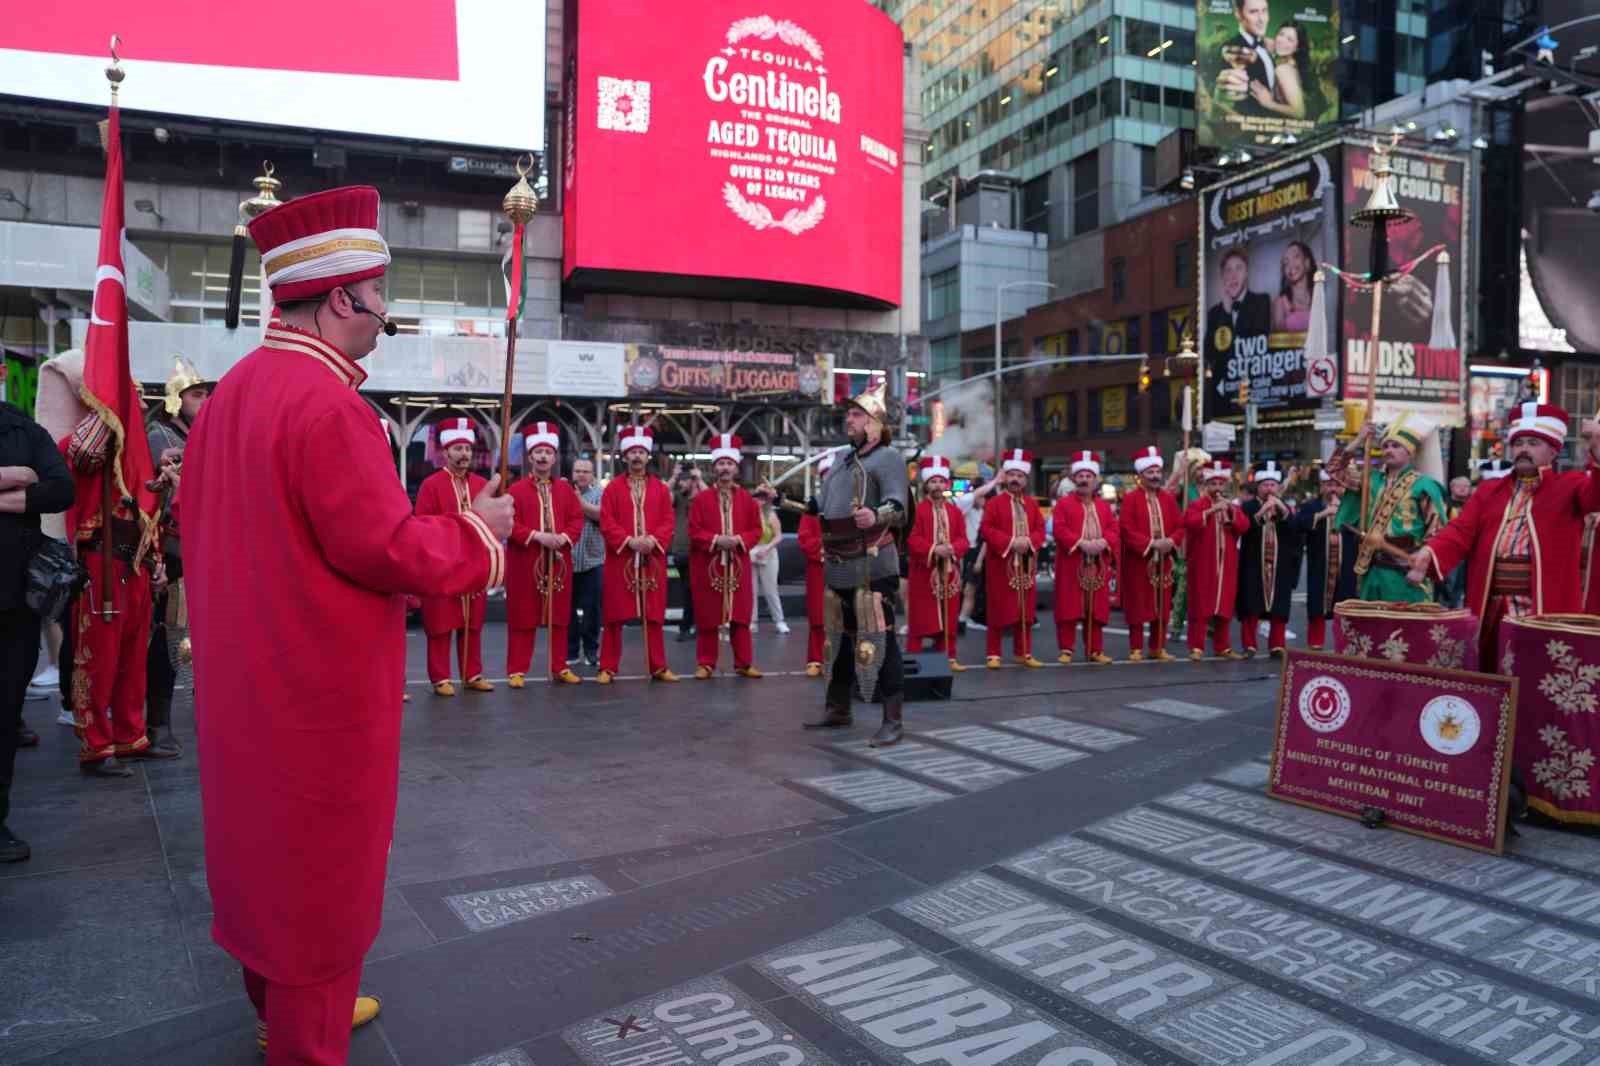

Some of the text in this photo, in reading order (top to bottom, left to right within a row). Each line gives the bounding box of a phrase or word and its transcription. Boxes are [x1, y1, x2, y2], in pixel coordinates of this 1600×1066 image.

[740, 48, 813, 72] TEQUILA
[702, 56, 842, 124] Centinela
[708, 120, 760, 147] AGED
[765, 127, 837, 162] TEQUILA
[730, 164, 820, 189] OVER 120 YEARS
[746, 182, 807, 202] OF LEGACY
[1400, 177, 1441, 202] COULD
[1256, 181, 1309, 215] MUSICAL
[1233, 334, 1267, 358] two
[660, 361, 711, 390] GIFTS
[1316, 737, 1372, 759] REPUBLIC
[1375, 749, 1393, 762] OF
[1286, 749, 1485, 801] MINISTRY OF NATIONAL DEFENSE
[1327, 776, 1425, 808] MEHTERAN UNIT
[463, 880, 589, 907] WINTER
[473, 889, 597, 924] GARDEN
[1160, 833, 1524, 950] FONTANNE
[1010, 855, 1368, 995] LONGACRE
[1122, 866, 1413, 976] BARRYMORE
[949, 903, 1214, 1021] KERR
[1363, 980, 1600, 1066] FRIED
